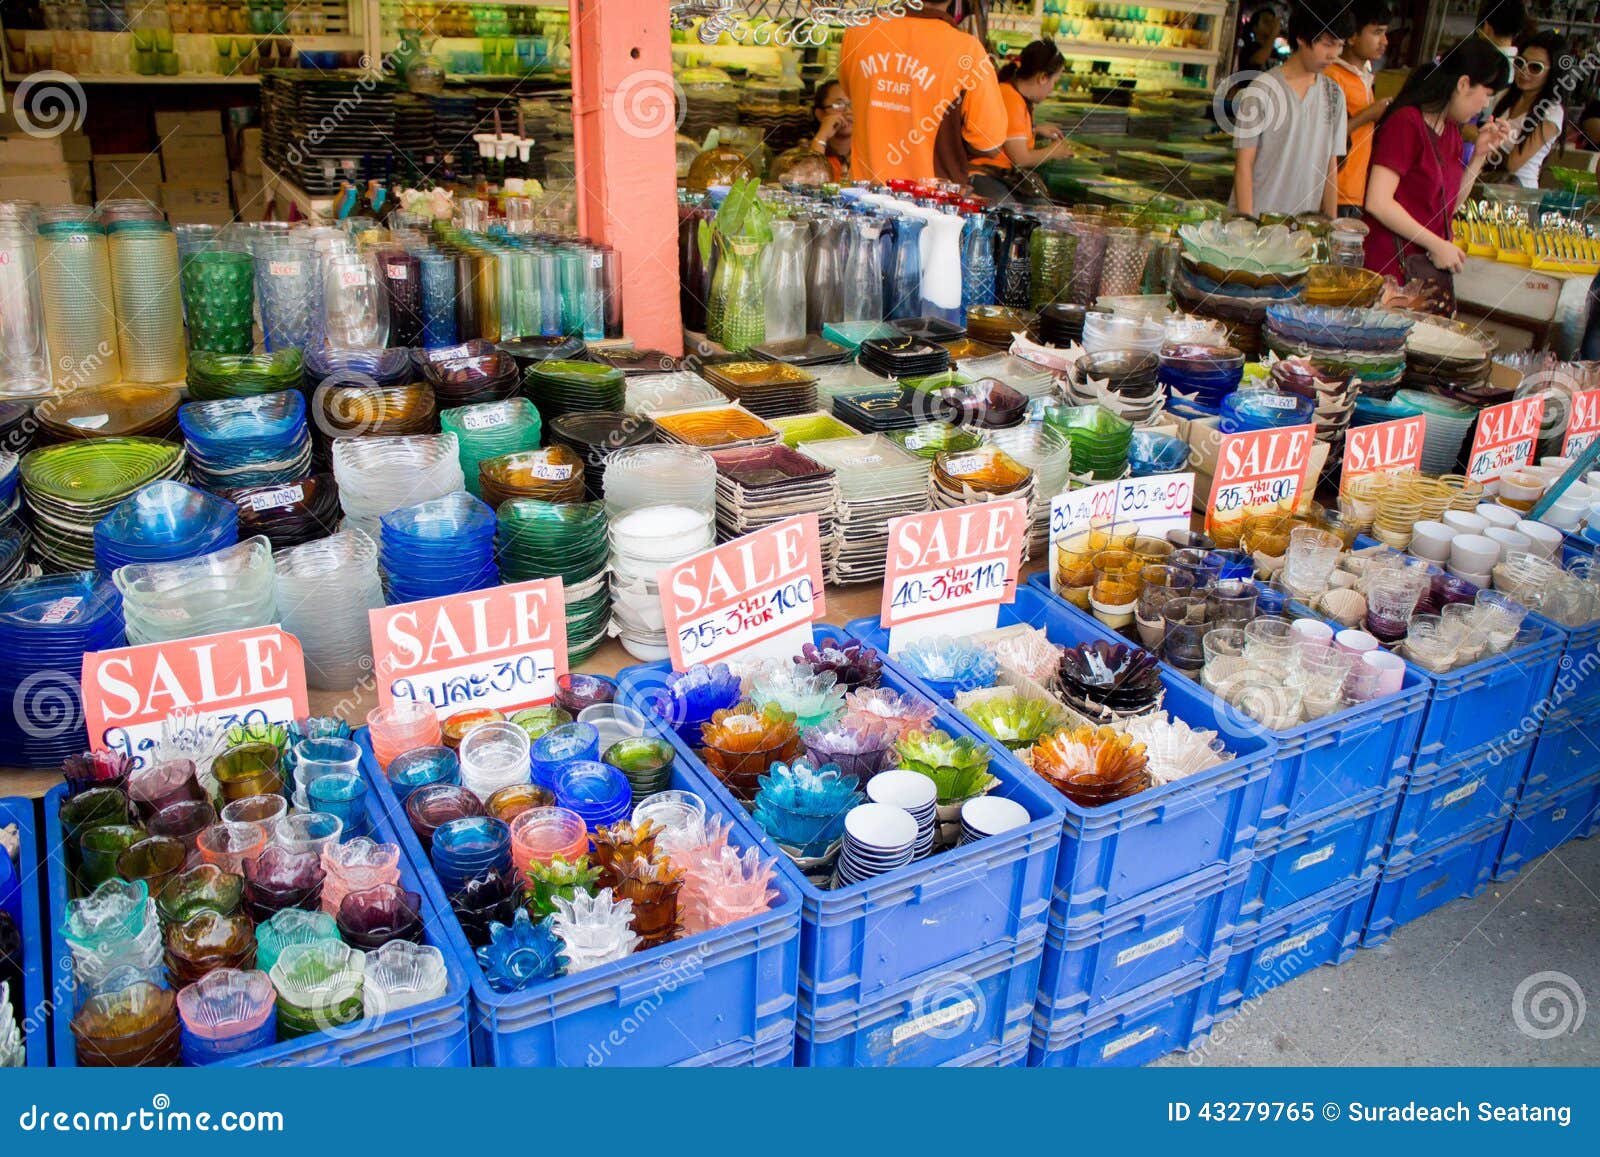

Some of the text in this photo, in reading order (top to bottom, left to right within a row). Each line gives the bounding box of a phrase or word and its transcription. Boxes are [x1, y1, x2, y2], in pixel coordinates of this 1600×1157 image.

[860, 52, 936, 91] MY THAI
[877, 79, 911, 95] STAFF
[1477, 399, 1540, 448] SALE
[1571, 393, 1600, 431] SA
[1221, 430, 1308, 480] SALE
[1348, 421, 1419, 472] SALE
[895, 507, 1014, 571] SALE
[672, 521, 808, 621] SALE
[947, 582, 974, 599] FOR
[387, 588, 551, 671] SALE
[743, 607, 774, 630] FOR
[96, 634, 289, 722] SALE
